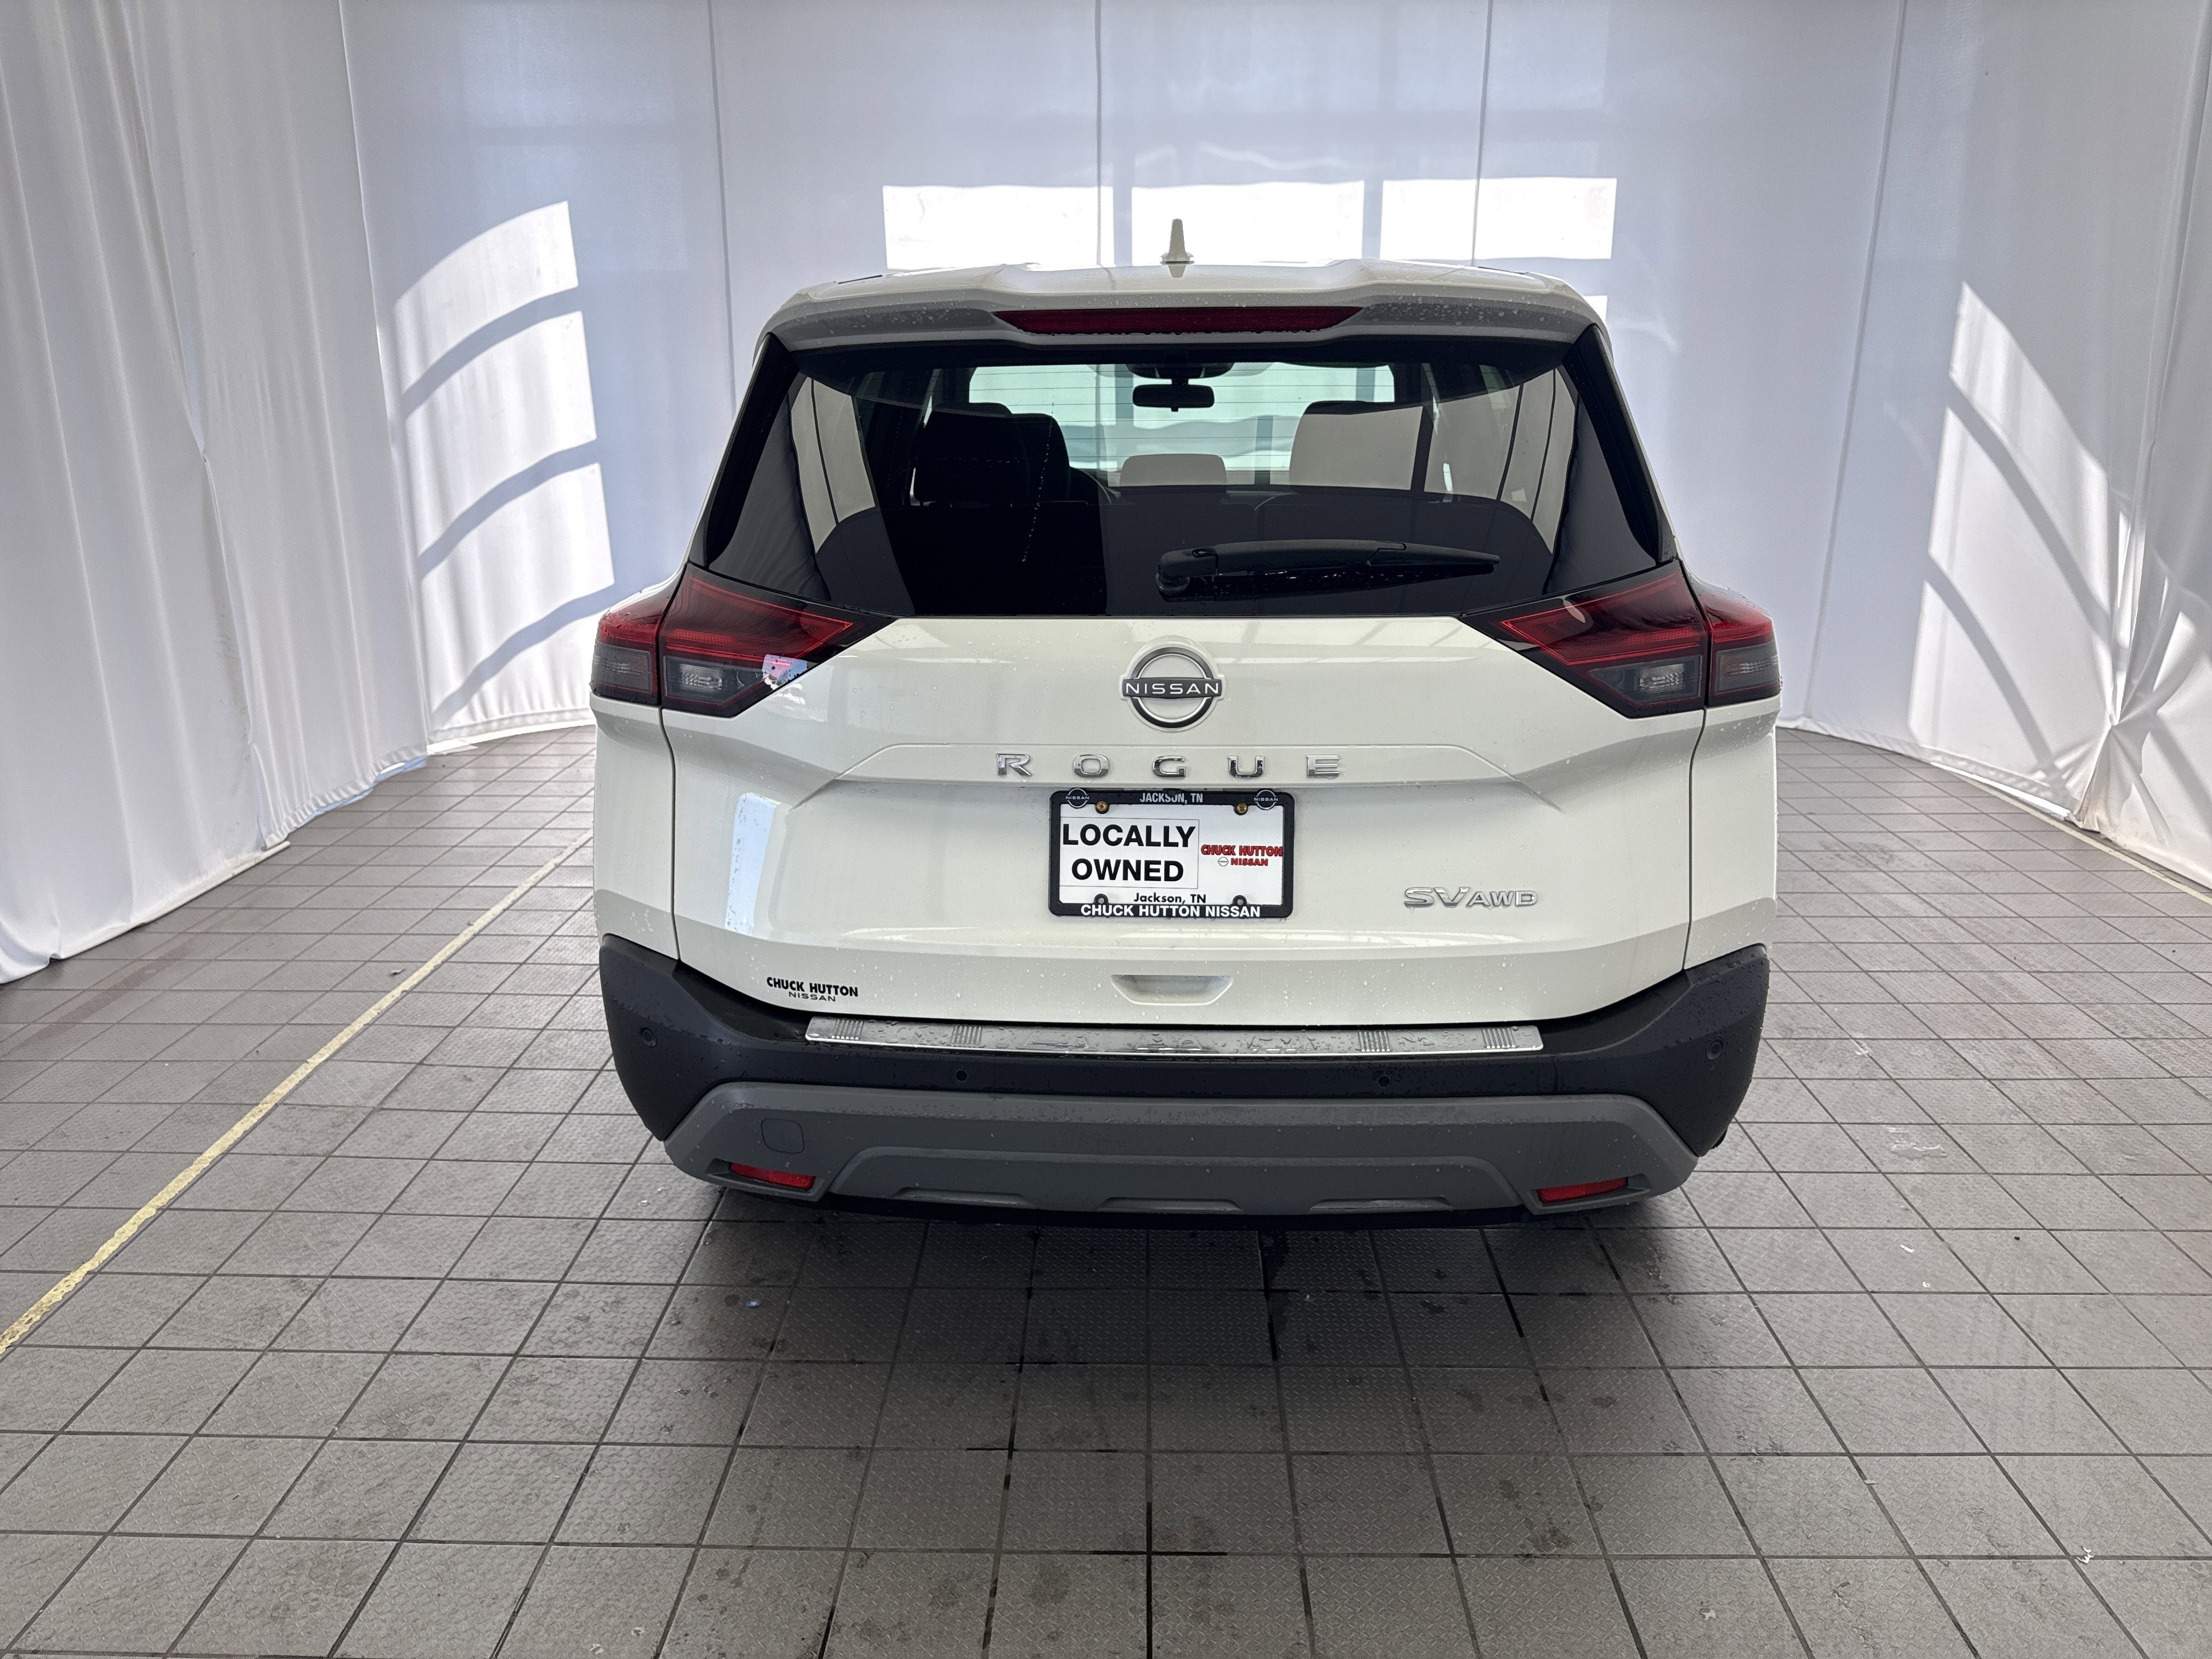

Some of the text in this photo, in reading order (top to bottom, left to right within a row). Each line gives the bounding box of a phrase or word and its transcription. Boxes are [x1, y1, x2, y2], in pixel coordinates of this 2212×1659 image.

[1126, 682, 1219, 695] NISSAN
[996, 753, 1341, 778] ROGUE
[1139, 793, 1203, 804] JACKSON, TN
[1063, 824, 1196, 848] LOCALLY
[1201, 844, 1283, 857] CHUCK HUTTON
[1071, 859, 1184, 882] OWNED
[1133, 893, 1206, 905] Jackson, TN
[1081, 904, 1260, 917] CHUCK HUTTON NISSAN
[767, 977, 859, 997] CHUCK HUTTON
[789, 991, 836, 1002] NISSAN
